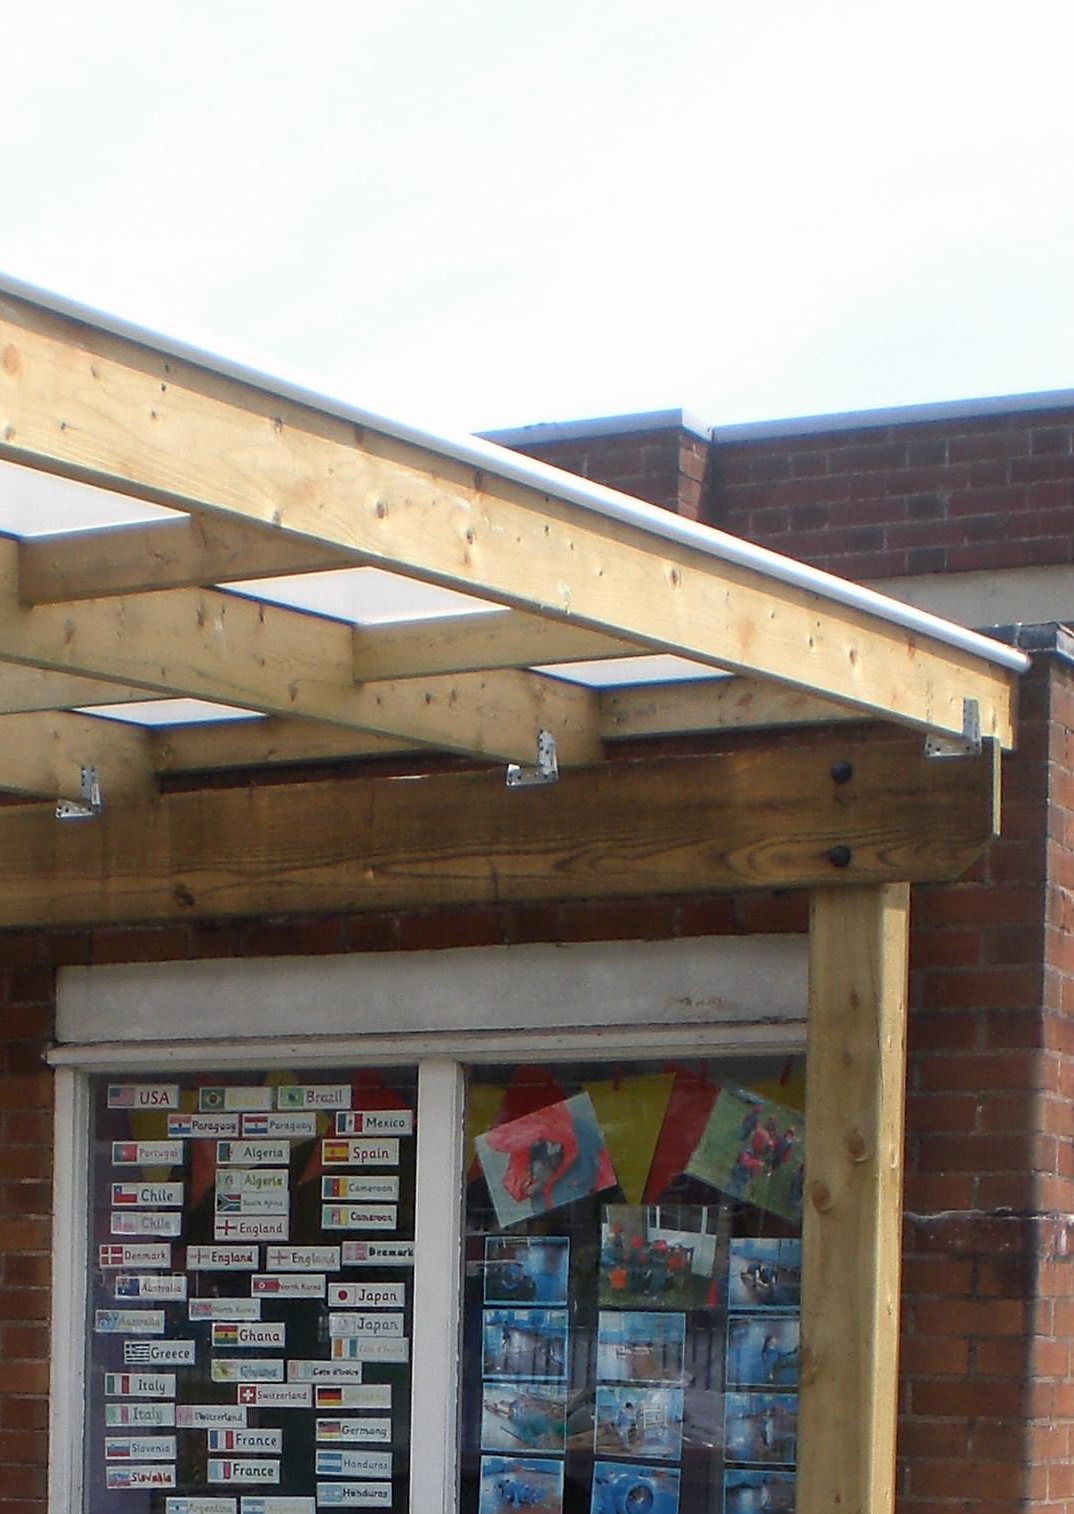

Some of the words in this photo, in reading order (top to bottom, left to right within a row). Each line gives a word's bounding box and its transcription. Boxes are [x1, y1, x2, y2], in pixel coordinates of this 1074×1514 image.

[140, 1090, 170, 1105] USA
[306, 1090, 343, 1103] Brazil
[192, 1120, 236, 1134] Paraguay
[269, 1120, 312, 1132] Paraguay
[366, 1118, 405, 1128] Mexico
[139, 1148, 178, 1160] Portugal
[244, 1147, 283, 1161] Algeria
[353, 1146, 389, 1163] Spain
[245, 1175, 283, 1189] Algeria
[348, 1183, 393, 1192] Cameroon
[141, 1188, 174, 1202] Chile
[350, 1211, 393, 1222] Cameroon
[141, 1217, 171, 1230] Chile
[239, 1222, 283, 1237] England
[124, 1250, 167, 1261] Denmark
[211, 1251, 253, 1265] England
[291, 1252, 335, 1266] England
[141, 1283, 182, 1293] Australia
[358, 1289, 397, 1305] Japan
[357, 1317, 399, 1334] Japan
[239, 1328, 280, 1342] Ghana
[151, 1347, 190, 1359] Greece
[138, 1379, 166, 1395] Italy
[257, 1390, 307, 1401] Switzerland
[133, 1407, 163, 1425] Italy
[341, 1425, 387, 1438] Germany
[235, 1433, 277, 1446] France
[132, 1443, 170, 1453] Slovenia
[232, 1464, 274, 1477] France
[343, 1458, 388, 1470] Honduras
[342, 1488, 388, 1498] Honduras
[188, 1503, 233, 1514] Argentina
